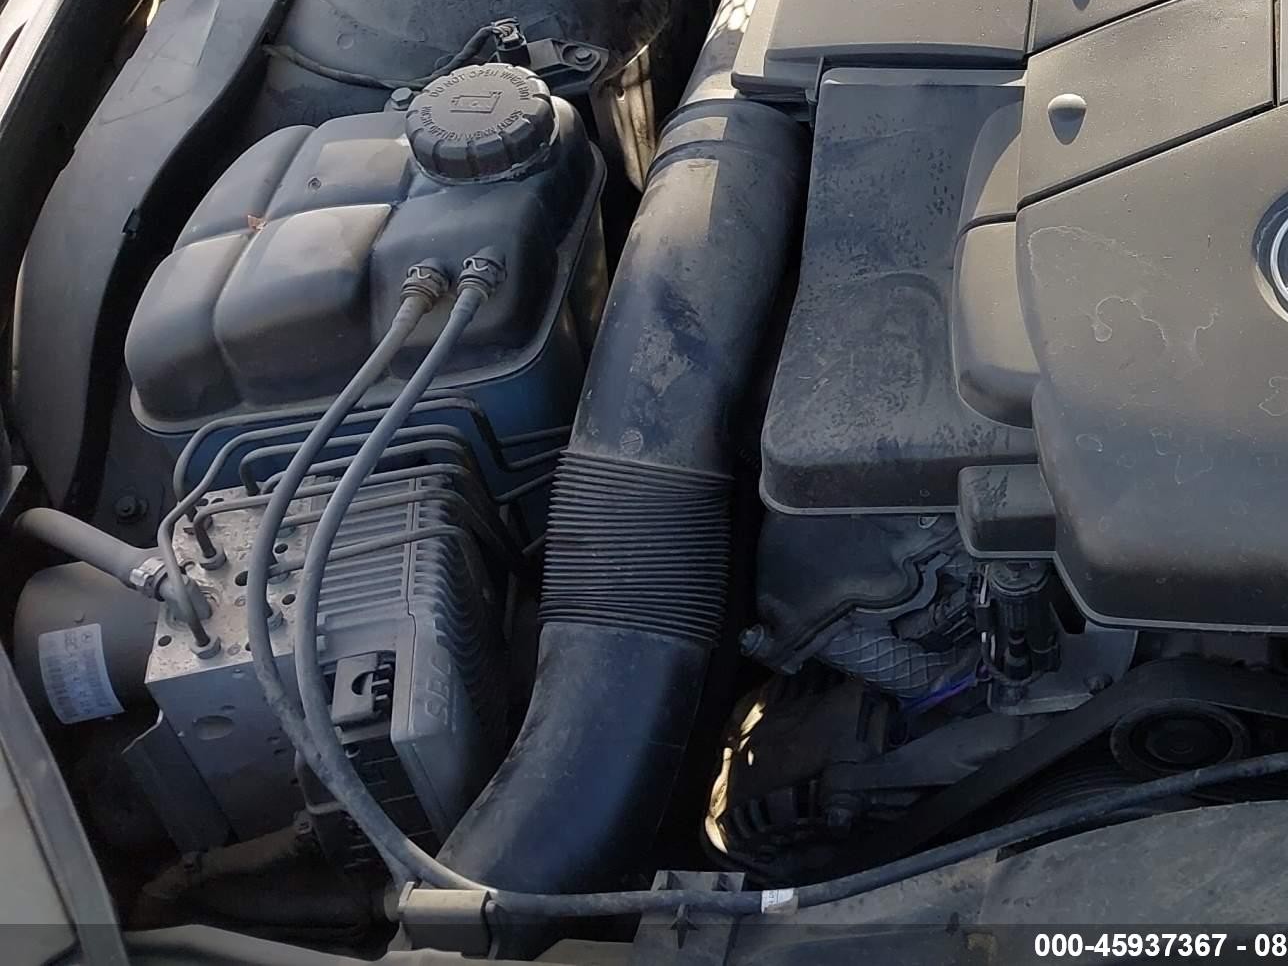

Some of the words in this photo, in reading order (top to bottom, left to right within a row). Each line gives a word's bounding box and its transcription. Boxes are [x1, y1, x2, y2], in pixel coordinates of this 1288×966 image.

[429, 86, 443, 97] DO
[445, 73, 465, 88] NOT
[469, 69, 498, 79] OPEN
[500, 70, 524, 87] WHEN
